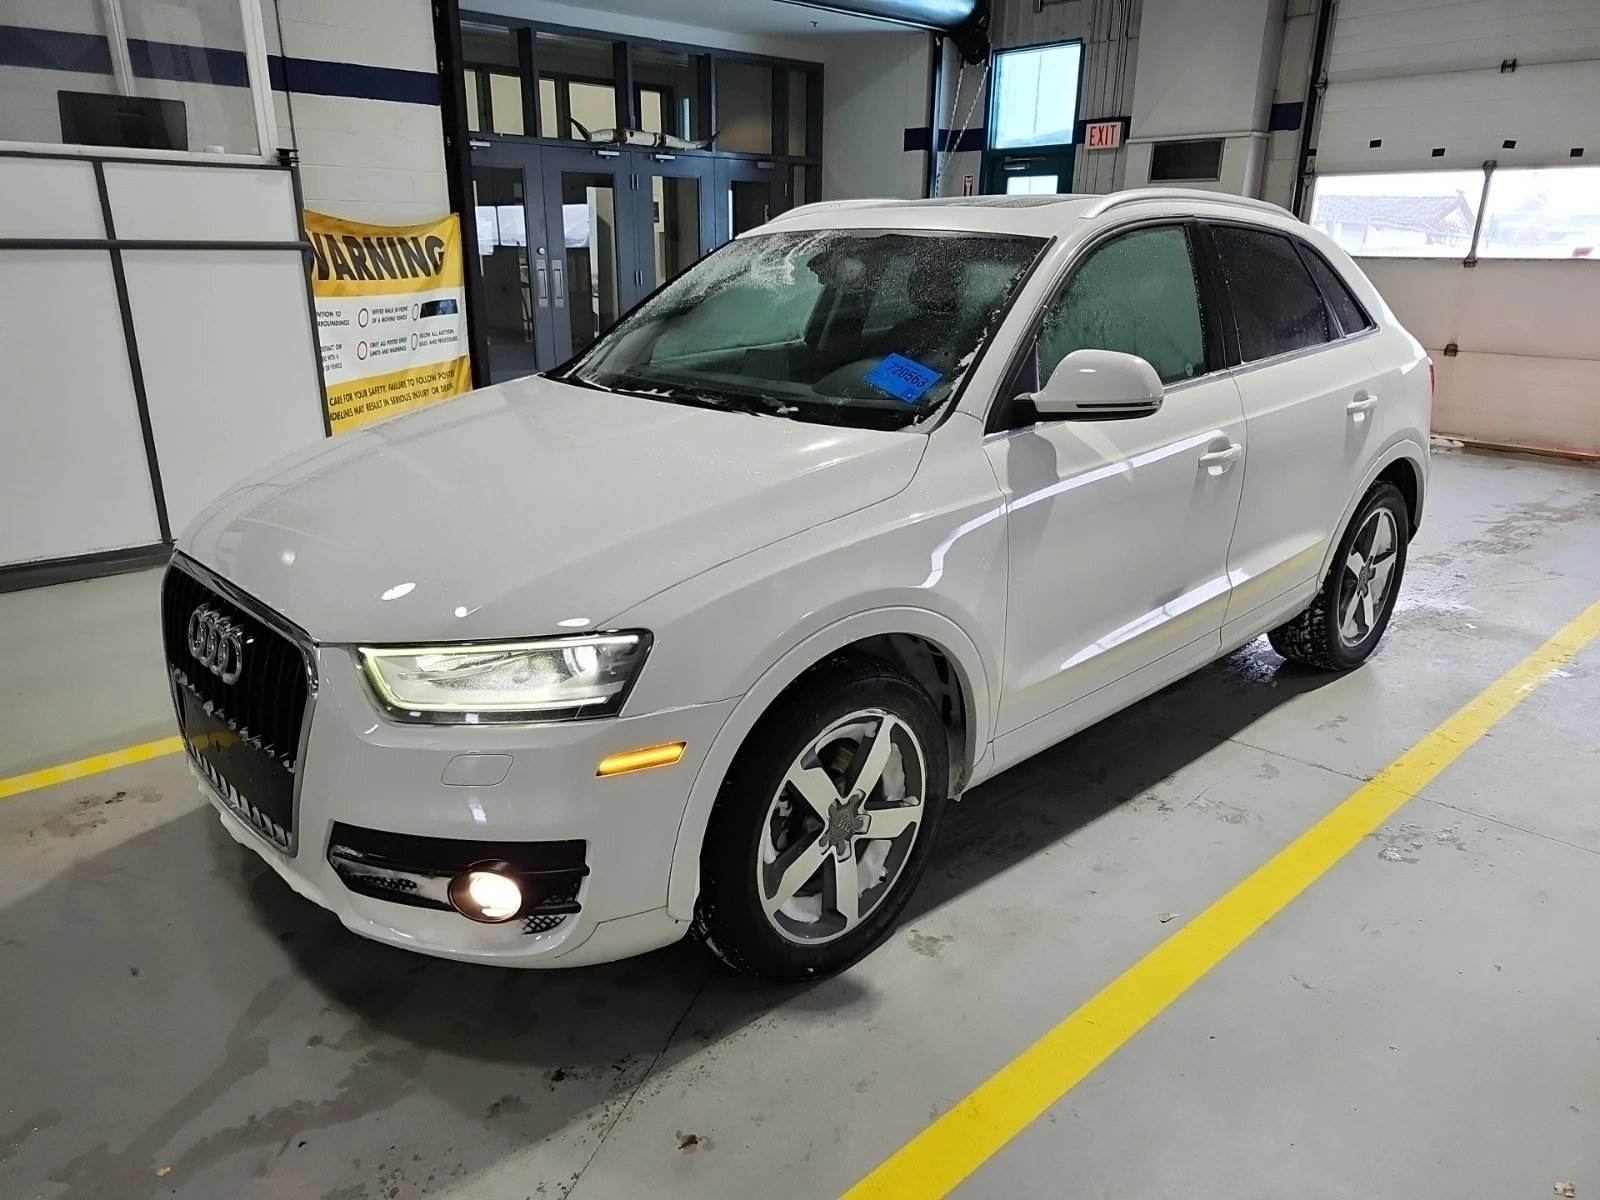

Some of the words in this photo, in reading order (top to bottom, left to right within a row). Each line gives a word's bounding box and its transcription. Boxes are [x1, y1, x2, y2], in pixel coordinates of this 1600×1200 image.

[1089, 125, 1117, 146] EXIT
[886, 362, 929, 388] 720563
[329, 396, 343, 407] CARE
[343, 392, 353, 403] FOR
[353, 389, 368, 400] YOUR
[388, 380, 407, 391] FAILURE
[407, 378, 415, 387] TO
[415, 373, 437, 385] FOLLOW
[354, 405, 365, 415] MAY
[365, 399, 384, 411] RESULT
[383, 397, 390, 407] IN
[390, 392, 412, 405] SERIOUS
[412, 389, 430, 400] INJURY
[430, 386, 440, 395] OR
